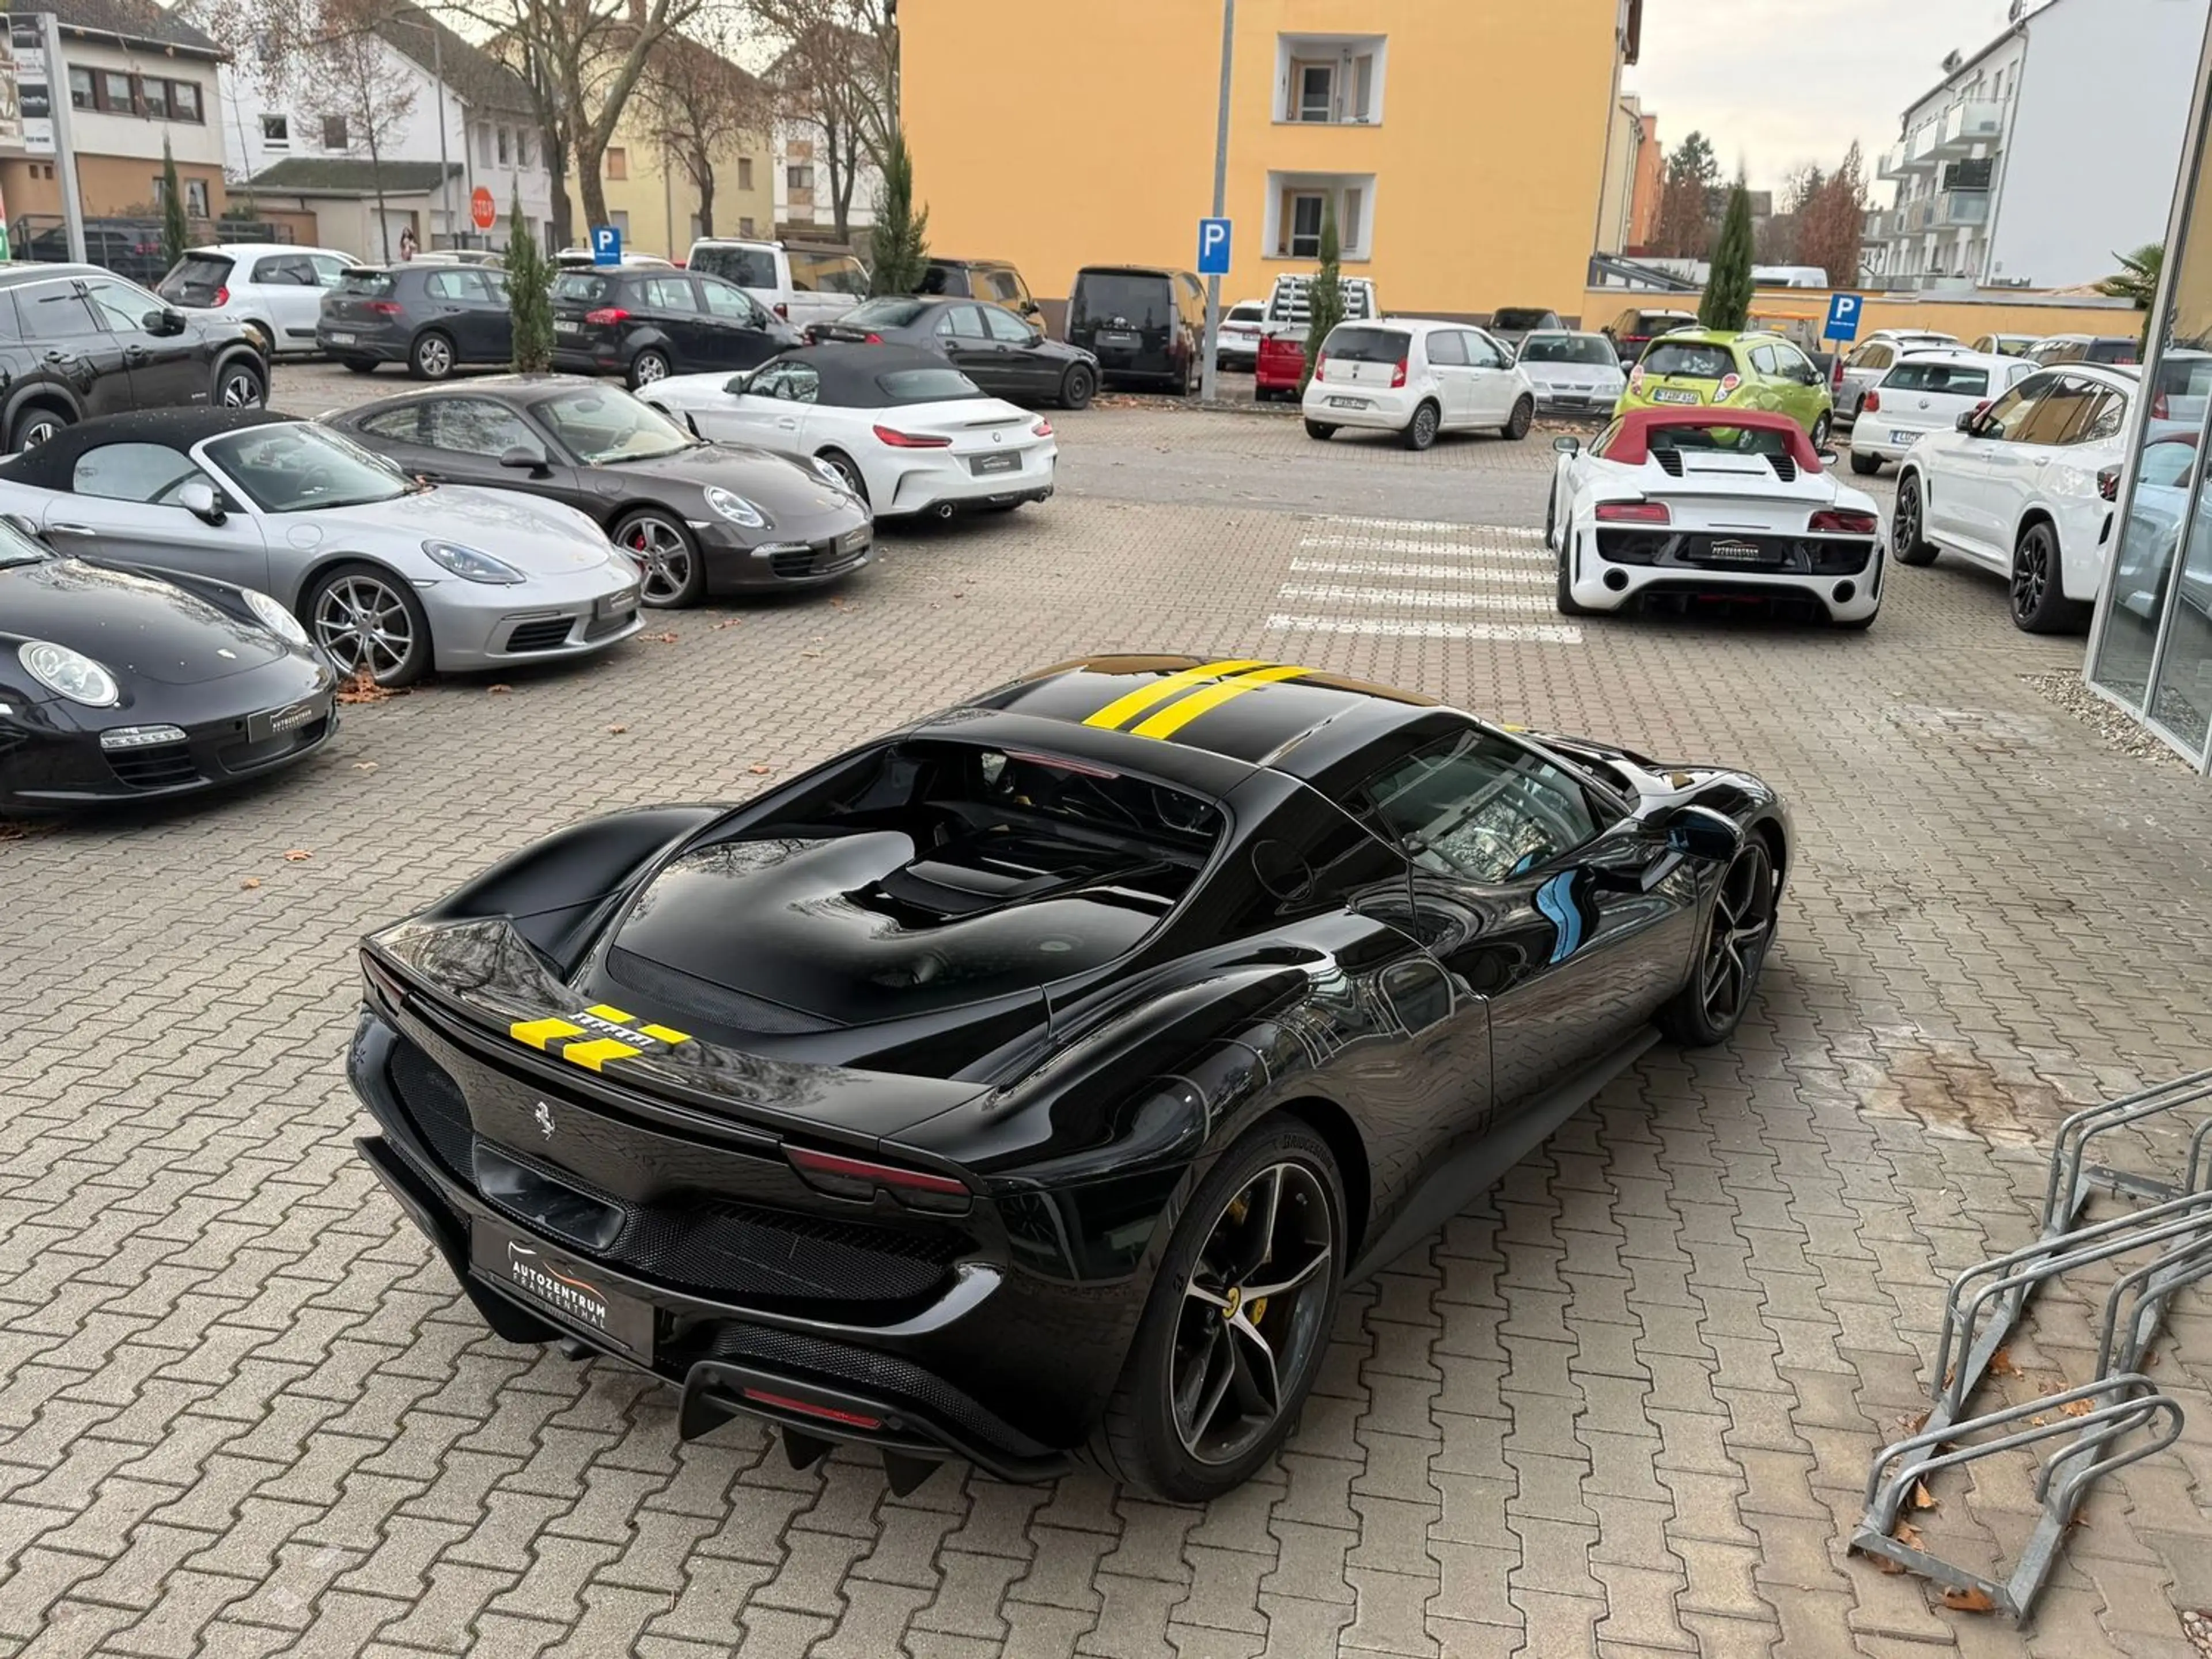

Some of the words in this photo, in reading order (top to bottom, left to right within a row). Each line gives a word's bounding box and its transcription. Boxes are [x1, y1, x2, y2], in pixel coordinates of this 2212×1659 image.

[474, 200, 493, 217] STOP
[599, 231, 614, 251] P
[1205, 224, 1225, 257] P
[1836, 297, 1855, 319] P
[512, 1261, 605, 1318] AUTOZENTRUM
[513, 1272, 605, 1329] FRANKENTHAL
